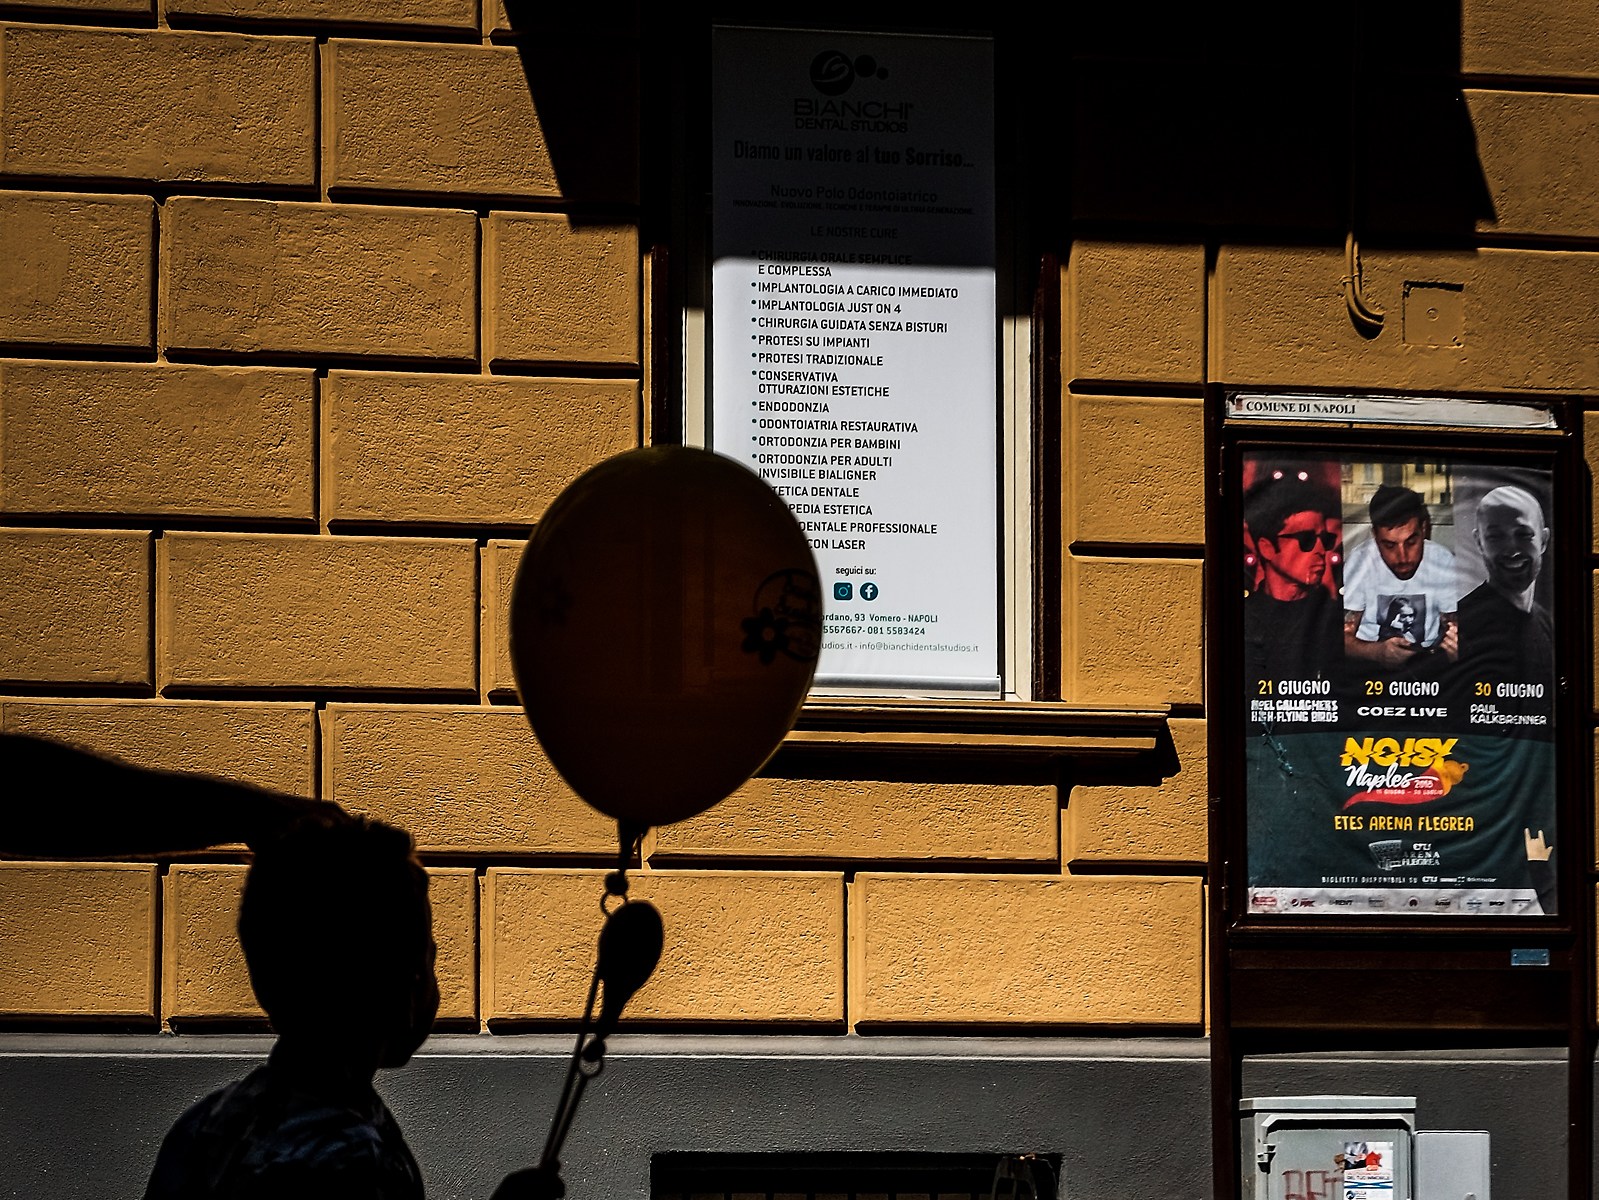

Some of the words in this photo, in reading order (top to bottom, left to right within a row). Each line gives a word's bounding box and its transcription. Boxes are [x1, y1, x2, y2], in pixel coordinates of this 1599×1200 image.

[793, 98, 909, 120] BIANCHI
[795, 118, 848, 131] DENTAL
[851, 121, 908, 133] STUDIOS
[734, 140, 780, 160] Diamo
[785, 146, 802, 161] un
[807, 144, 851, 163] valore
[856, 146, 869, 164] al
[875, 149, 900, 164] tuo
[905, 148, 974, 168] Sorriso...
[771, 184, 812, 199] Nuovo
[816, 186, 845, 200] Polo
[848, 187, 938, 203] Odontoiatrico
[811, 225, 824, 237] LE
[826, 226, 867, 239] NOSTRE
[870, 227, 898, 240] CURE
[758, 250, 818, 263] CHIRURGIA
[820, 251, 856, 264] ORALE
[858, 253, 912, 265] SEMPLICE
[758, 264, 765, 275] E
[767, 265, 832, 277] COMPLESSA
[758, 281, 845, 295] IMPLANTOLOGIA
[846, 284, 855, 295] A
[856, 284, 896, 297] CARICO
[898, 286, 959, 299] IMMEDIATO
[758, 299, 846, 313] IMPLANTOLOGIA
[846, 302, 874, 314] JUST
[875, 303, 891, 314] ON
[893, 304, 902, 314] 4
[758, 316, 819, 329] CHIRURGIA
[820, 319, 867, 331] GUIDATA
[868, 320, 904, 332] SENZA
[905, 321, 948, 334] BISTURI
[758, 334, 803, 347] PROTESI
[805, 336, 820, 347] SU
[822, 336, 870, 349] IMPIANTI
[758, 352, 804, 364] PROTESI
[805, 353, 884, 367] TRADIZIONALE
[758, 369, 839, 383] CONSERVATIVA
[758, 383, 829, 396] OTTURAZIONI
[831, 385, 890, 397] ESTETICHE
[758, 400, 830, 413] ENDODONZIA
[1246, 401, 1296, 412] COMUNE
[1298, 403, 1310, 413] DI
[1313, 403, 1356, 415] NAPOLI
[759, 418, 839, 431] ODONTOIATRIA
[840, 420, 919, 433] RESTAURATIVA
[758, 435, 828, 448] ORTODONZIA
[830, 437, 852, 449] PER
[854, 438, 901, 450] BAMBINI
[758, 453, 829, 466] ORTODONZIA
[830, 455, 852, 466] PER
[853, 456, 892, 467] ADULTI
[758, 468, 816, 479] INVISIBILE
[818, 469, 877, 481] BIALIGNER
[772, 486, 808, 496] TETICA
[810, 486, 860, 498] DENTALE
[823, 504, 873, 516] ESTETICA
[798, 521, 847, 532] DENTALE
[850, 522, 938, 535] PROFESSIONALE
[807, 538, 829, 549] CON
[831, 539, 866, 550] LASER
[835, 567, 863, 577] seguici
[854, 613, 866, 622] 93
[869, 614, 901, 623] Vomero
[908, 614, 938, 623] NAPOLI
[867, 627, 884, 635] 081
[886, 627, 926, 635] 5583424
[859, 642, 979, 652] info@bianchidentalstudios.it
[1257, 679, 1273, 695] 21
[1278, 679, 1331, 695] GIUGNO
[1364, 680, 1384, 696] 29
[1388, 681, 1440, 696] GIUGNO
[1474, 682, 1492, 696] 30
[1496, 682, 1545, 699] GIUGNO
[1356, 706, 1406, 717] COEZ
[1410, 707, 1448, 717] LIVE
[1470, 703, 1499, 714] PAUL
[1339, 737, 1459, 768] NOISY
[1344, 762, 1440, 794] Naples
[1334, 815, 1364, 831] ETES
[1369, 815, 1413, 831] ARENA
[1418, 815, 1475, 832] FLEGREA
